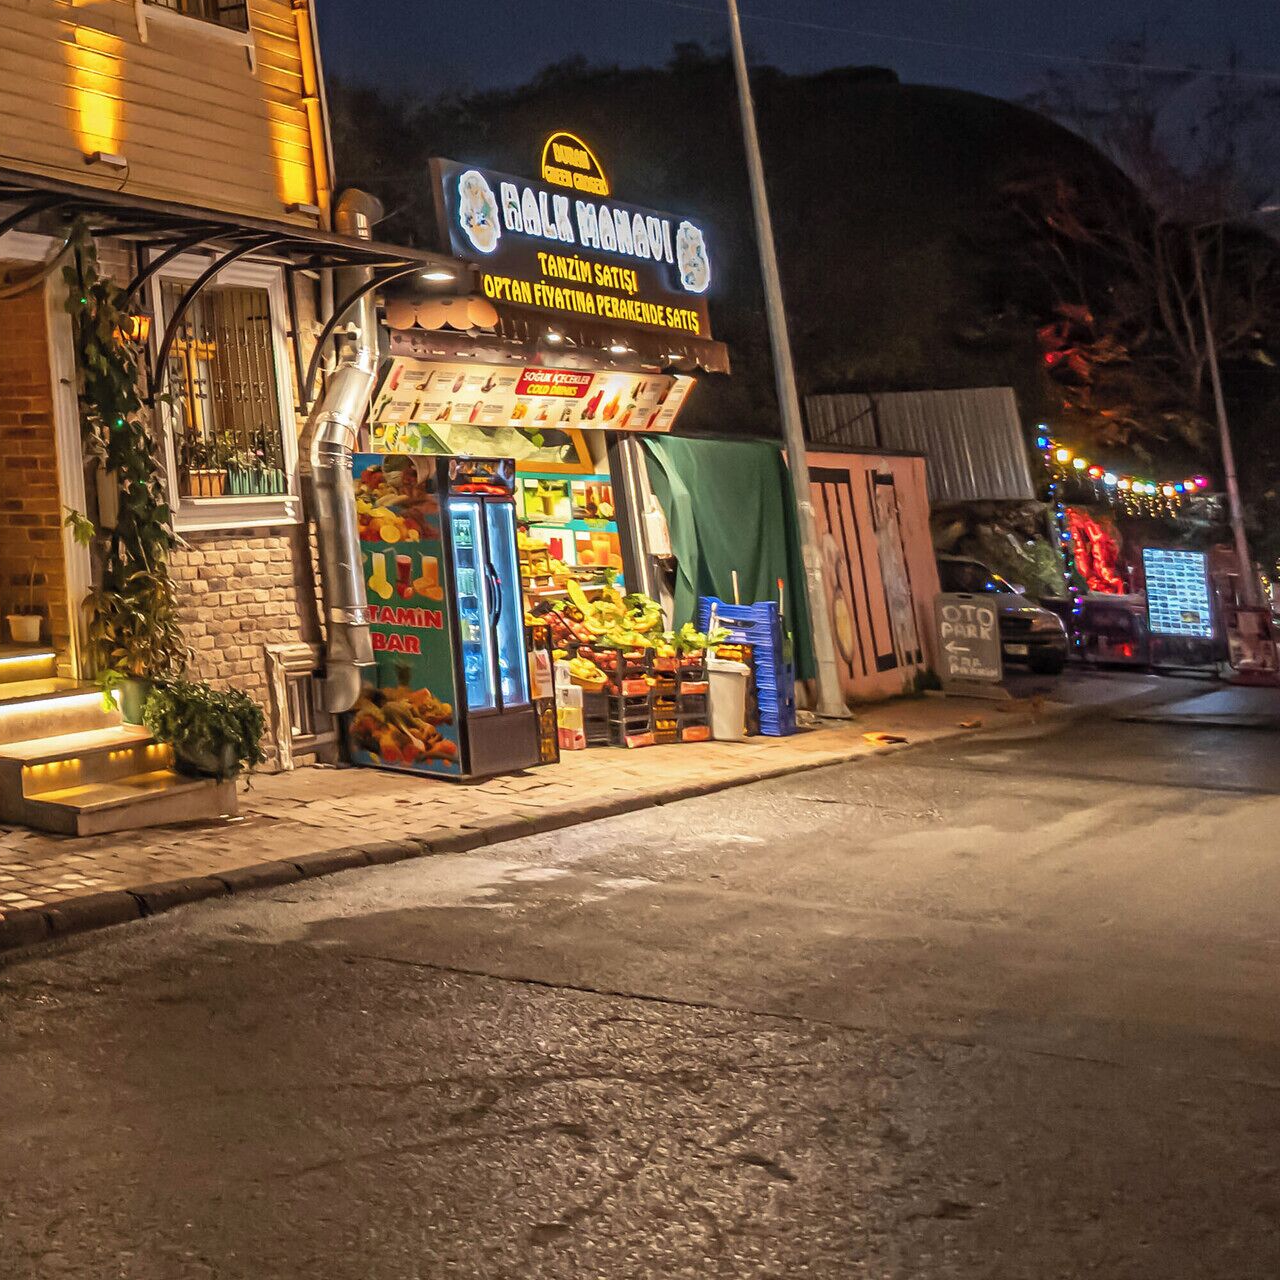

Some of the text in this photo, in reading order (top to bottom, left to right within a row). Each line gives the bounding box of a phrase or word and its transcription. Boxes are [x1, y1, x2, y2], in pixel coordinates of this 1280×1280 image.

[500, 181, 674, 264] HALK MANAVI
[538, 252, 638, 295] TANZİM SATIŞI
[482, 274, 700, 336] OPTAN FİYATINA PERAKENDE SATIŞ
[940, 622, 992, 641] PARK
[941, 604, 995, 628] OTO
[370, 632, 422, 655] BAR
